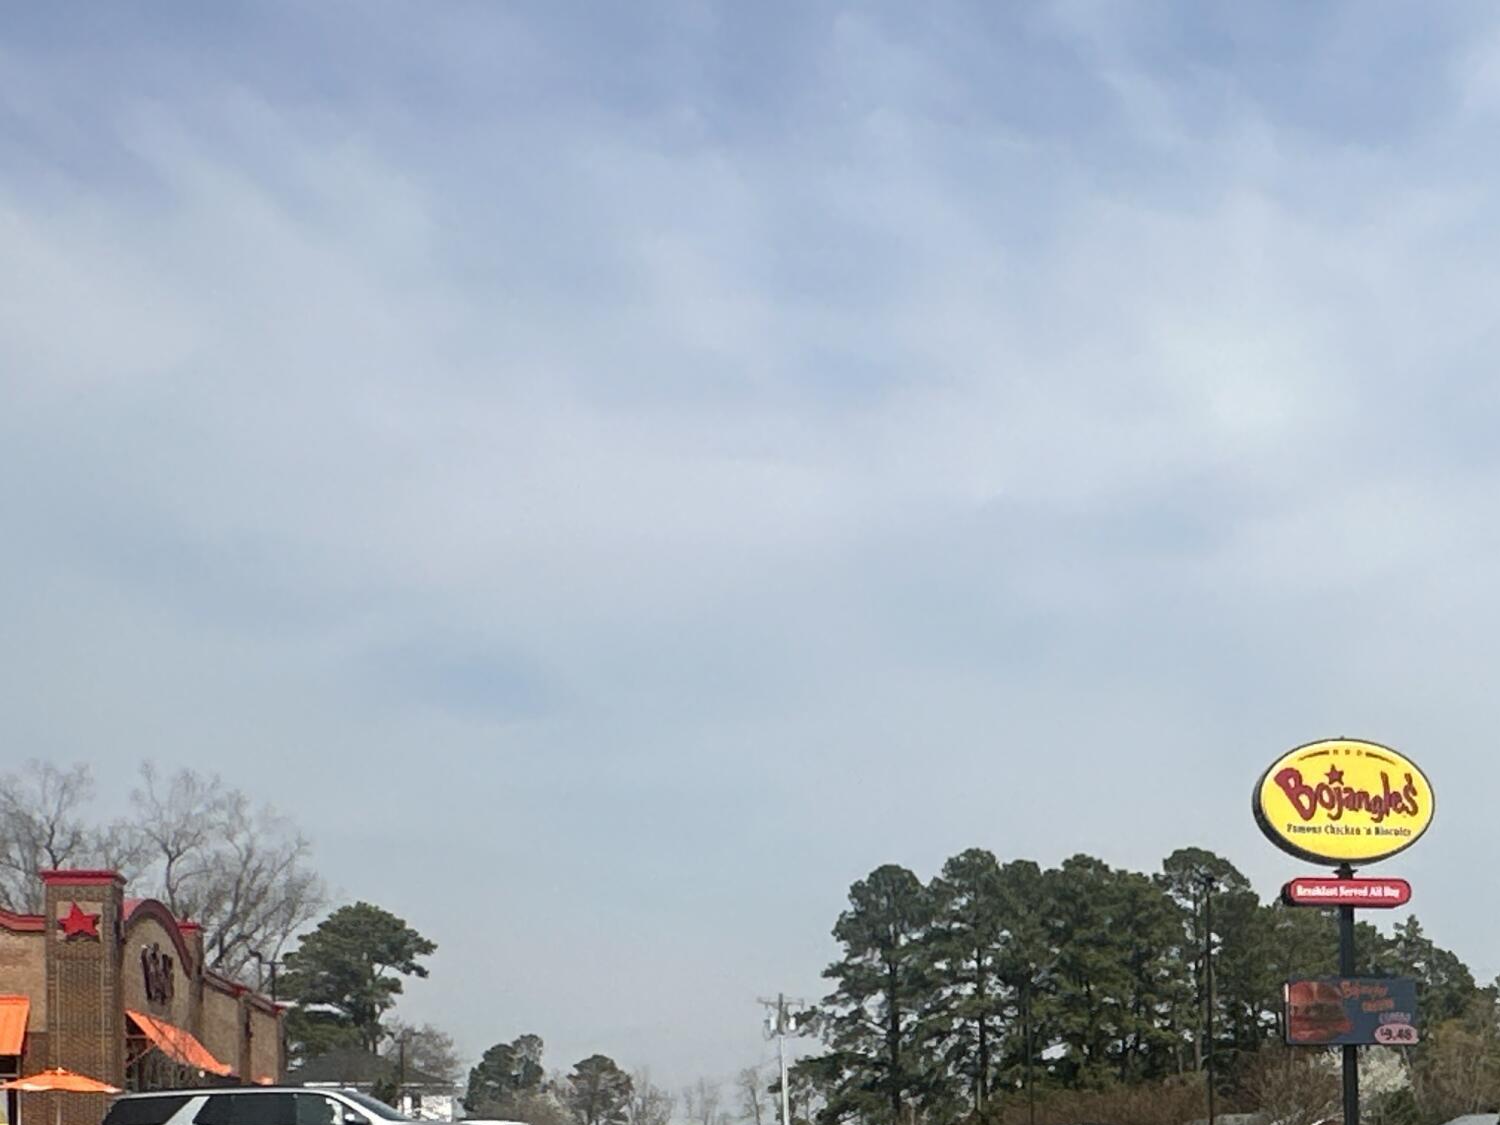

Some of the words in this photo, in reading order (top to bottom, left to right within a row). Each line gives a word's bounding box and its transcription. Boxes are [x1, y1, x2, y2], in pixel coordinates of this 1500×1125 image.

[1287, 823, 1321, 834] Famous
[1324, 824, 1361, 836] Chicken
[1375, 826, 1411, 837] Biscuits
[1296, 885, 1338, 897] Breakfast
[1339, 886, 1367, 898] Served
[1369, 886, 1383, 897] All
